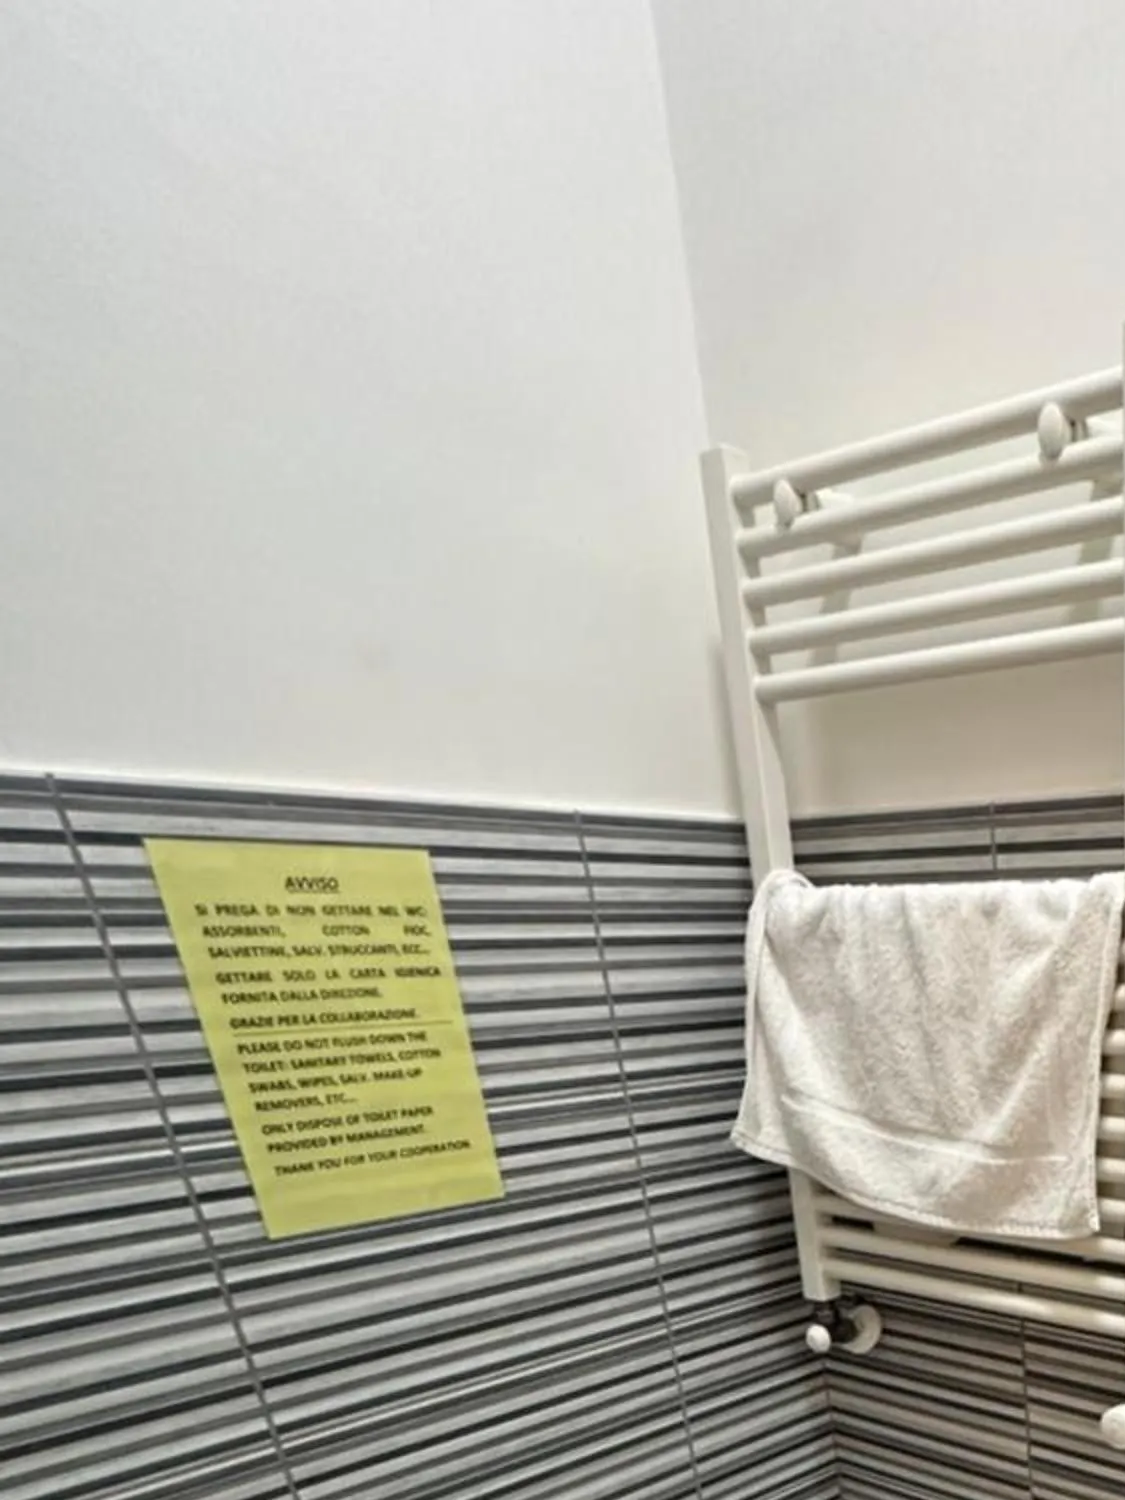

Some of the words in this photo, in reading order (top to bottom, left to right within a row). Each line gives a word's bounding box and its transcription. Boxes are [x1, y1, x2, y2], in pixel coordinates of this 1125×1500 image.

[285, 876, 340, 892] AVVISO
[215, 904, 259, 917] PREGA
[265, 904, 281, 917] DI
[322, 924, 370, 937] COTTON
[215, 969, 272, 984] GETTARE
[282, 969, 316, 982] SOLO
[325, 968, 341, 981] LA
[349, 967, 386, 980] CARTA
[280, 989, 319, 1002] DALLA
[229, 1014, 273, 1029] GRAZIE
[277, 1013, 299, 1027] PER
[302, 1013, 317, 1025] LA
[237, 1041, 282, 1055] PLEASE
[317, 1157, 342, 1171] YOU
[343, 1153, 366, 1166] FOR
[367, 1149, 398, 1163] YOUR
